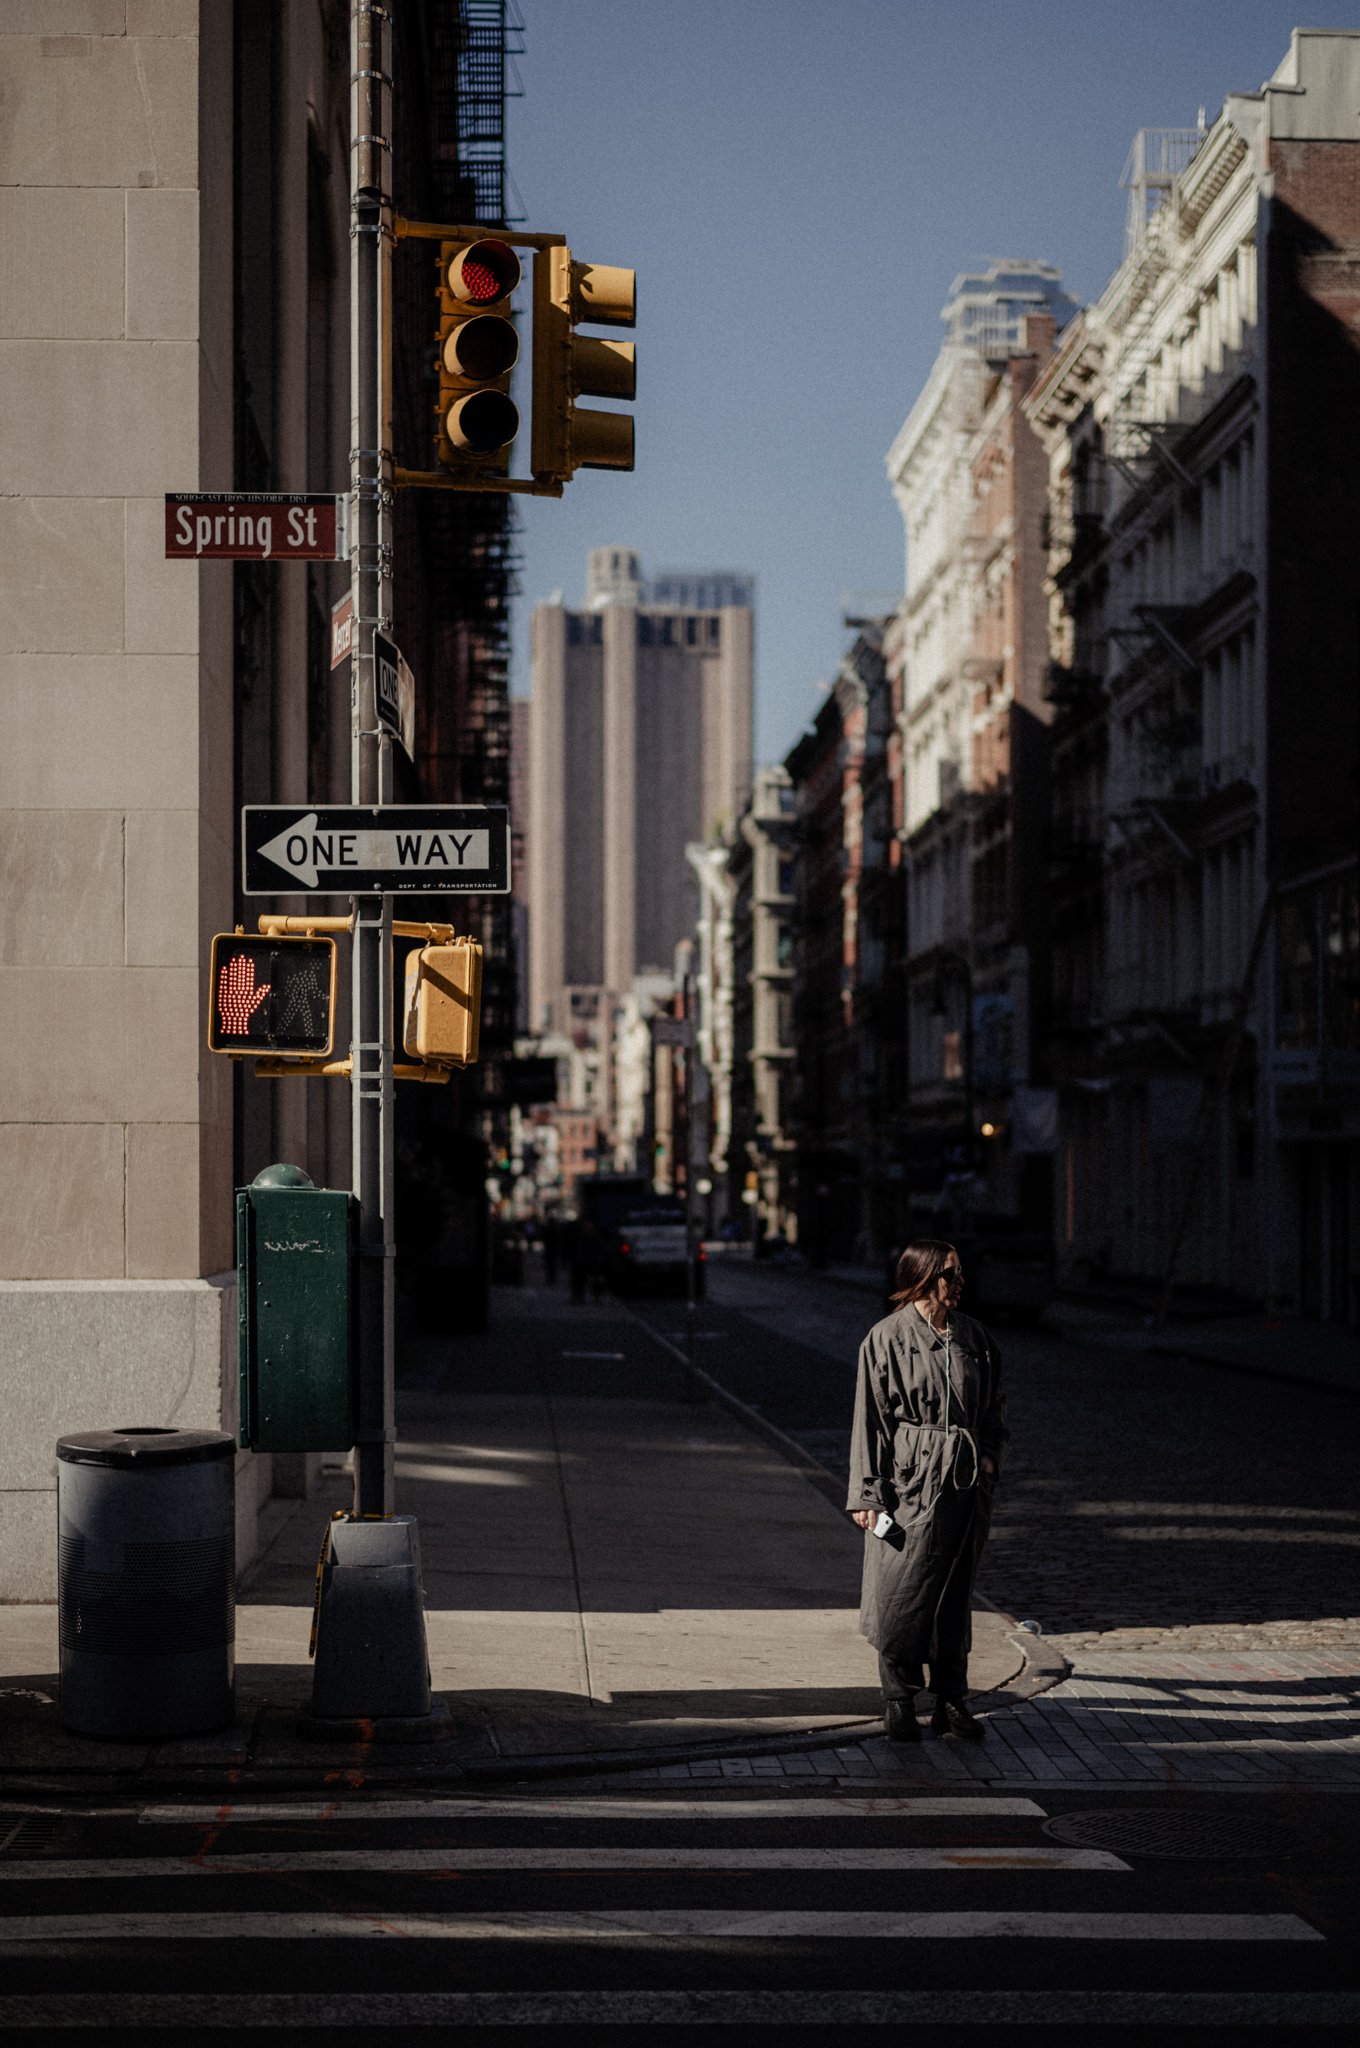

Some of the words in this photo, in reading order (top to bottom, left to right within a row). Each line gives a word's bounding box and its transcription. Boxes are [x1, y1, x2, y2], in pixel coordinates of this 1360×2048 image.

[225, 494, 244, 503] IRON
[248, 495, 285, 503] HISTORIC
[289, 495, 308, 504] DIST
[175, 505, 272, 559] Spring
[287, 506, 318, 547] St
[285, 834, 359, 866] ONE
[395, 834, 474, 866] WAY
